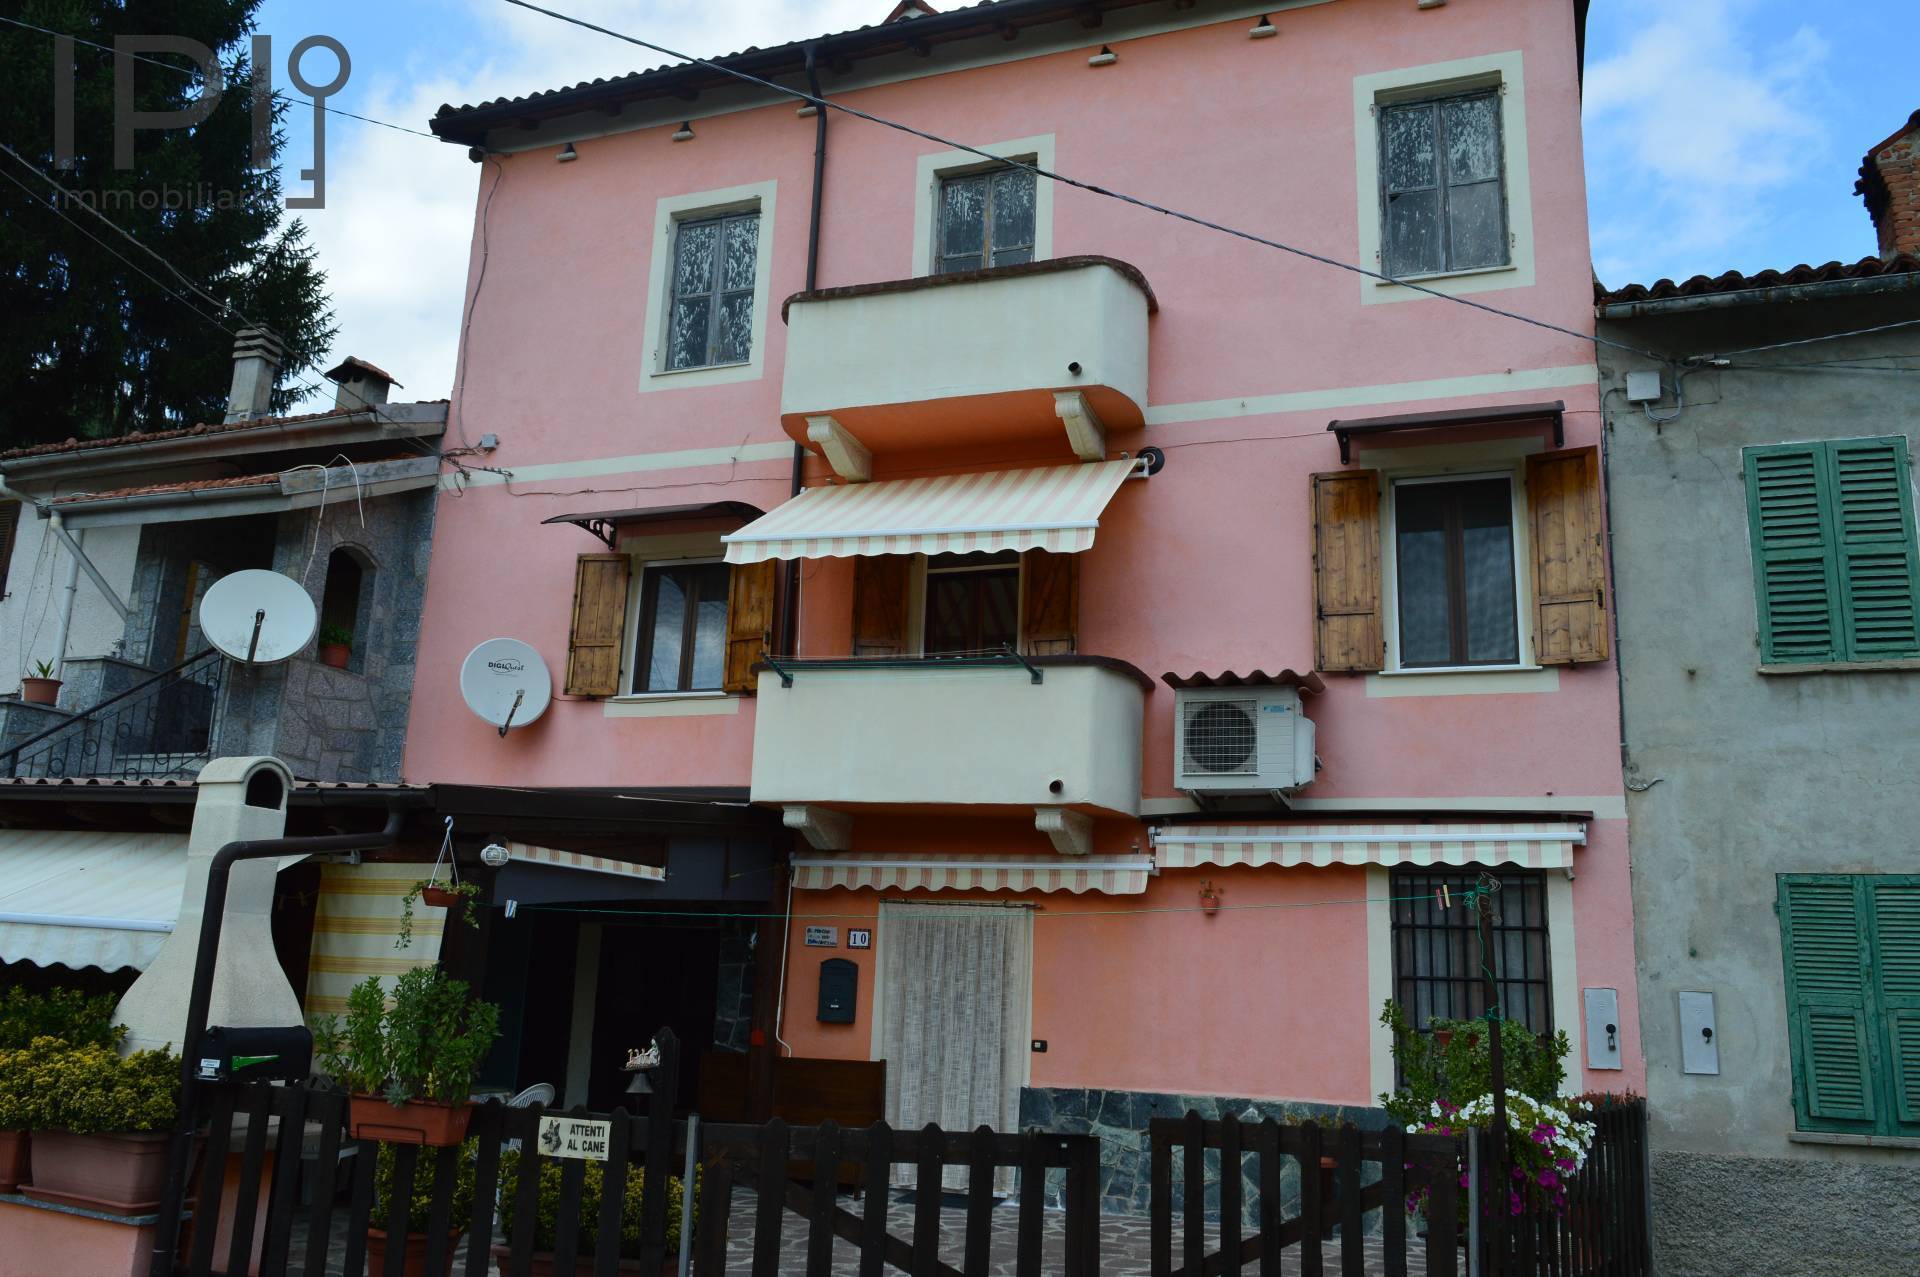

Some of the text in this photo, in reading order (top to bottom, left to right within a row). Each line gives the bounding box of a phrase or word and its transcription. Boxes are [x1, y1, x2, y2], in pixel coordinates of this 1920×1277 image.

[852, 932, 867, 945] 10
[569, 1124, 605, 1137] ATTENTI
[567, 1139, 605, 1153] AL CANE
